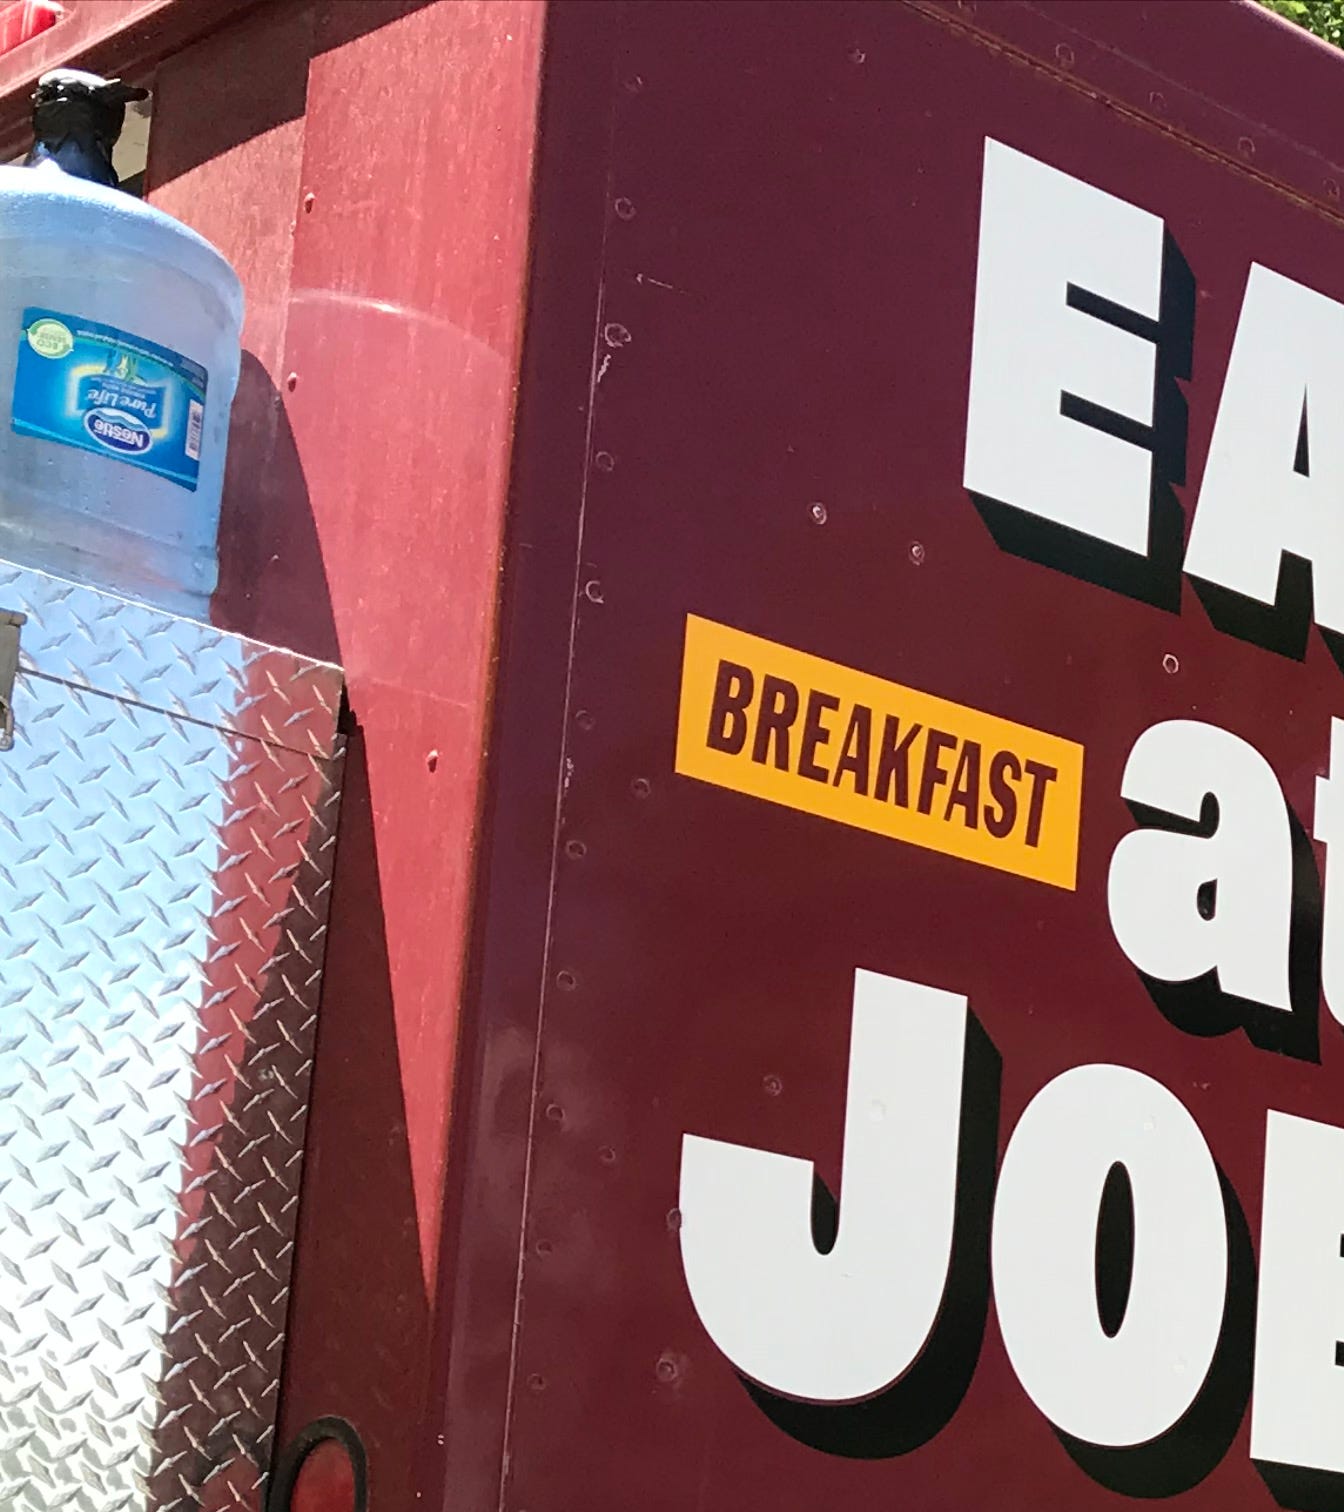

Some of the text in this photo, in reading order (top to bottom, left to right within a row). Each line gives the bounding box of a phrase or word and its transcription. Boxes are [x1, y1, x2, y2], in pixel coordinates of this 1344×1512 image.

[84, 388, 158, 419] Pure Life
[93, 419, 145, 448] Nestlé
[705, 658, 1060, 849] BREAKFAST
